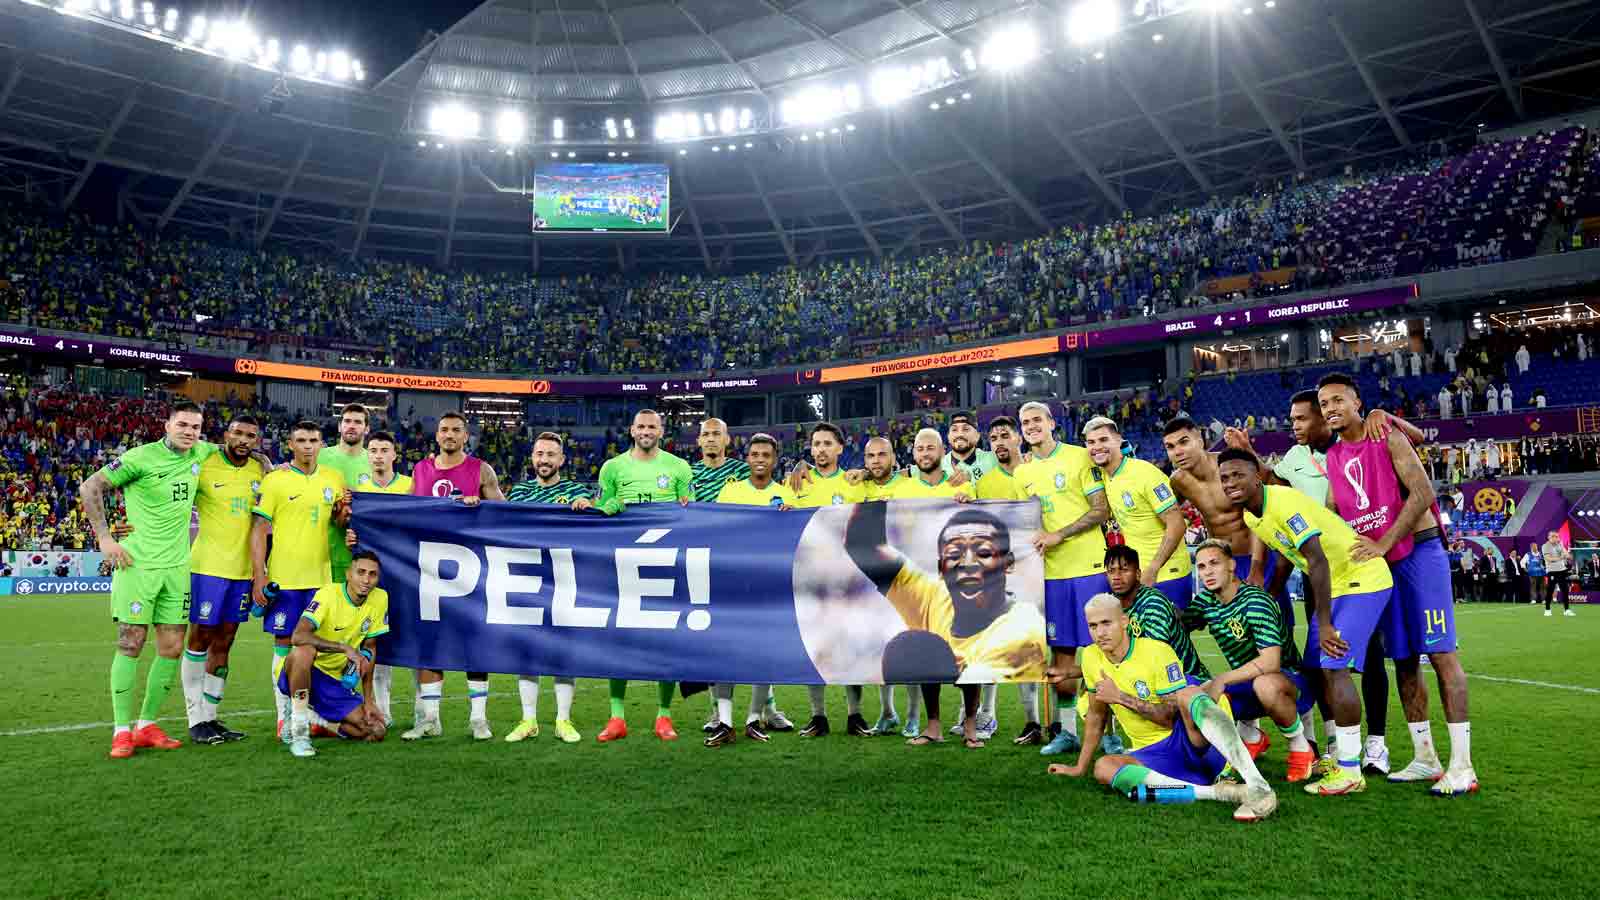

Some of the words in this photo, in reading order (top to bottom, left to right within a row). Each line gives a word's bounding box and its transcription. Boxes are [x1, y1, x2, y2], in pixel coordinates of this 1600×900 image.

[1165, 321, 1196, 333] BRAZIL
[1214, 315, 1223, 326] 4
[1244, 311, 1251, 322] 1
[1268, 306, 1300, 318] KOREA
[1301, 299, 1349, 313] REPUBLIC
[0, 335, 35, 346] BRAZIL
[54, 340, 64, 351] 4
[87, 343, 93, 354] 1
[110, 347, 138, 358] KOREA
[139, 351, 181, 362] REPUBLIC
[872, 365, 888, 374] FIFA
[888, 361, 916, 371] WORLD
[917, 358, 933, 367] CUP
[321, 371, 341, 380] FIFA
[342, 372, 375, 383] WORLD
[376, 376, 394, 385] CUP
[661, 382, 669, 391] 4
[684, 381, 690, 390] 1
[702, 380, 724, 388] KOREA
[725, 379, 758, 387] REPUBLIC
[172, 482, 189, 502] 23
[1356, 511, 1380, 525] WORLD
[38, 581, 113, 594] crypto.co
[418, 528, 711, 631] PELÉ!
[1424, 608, 1447, 634] 14
